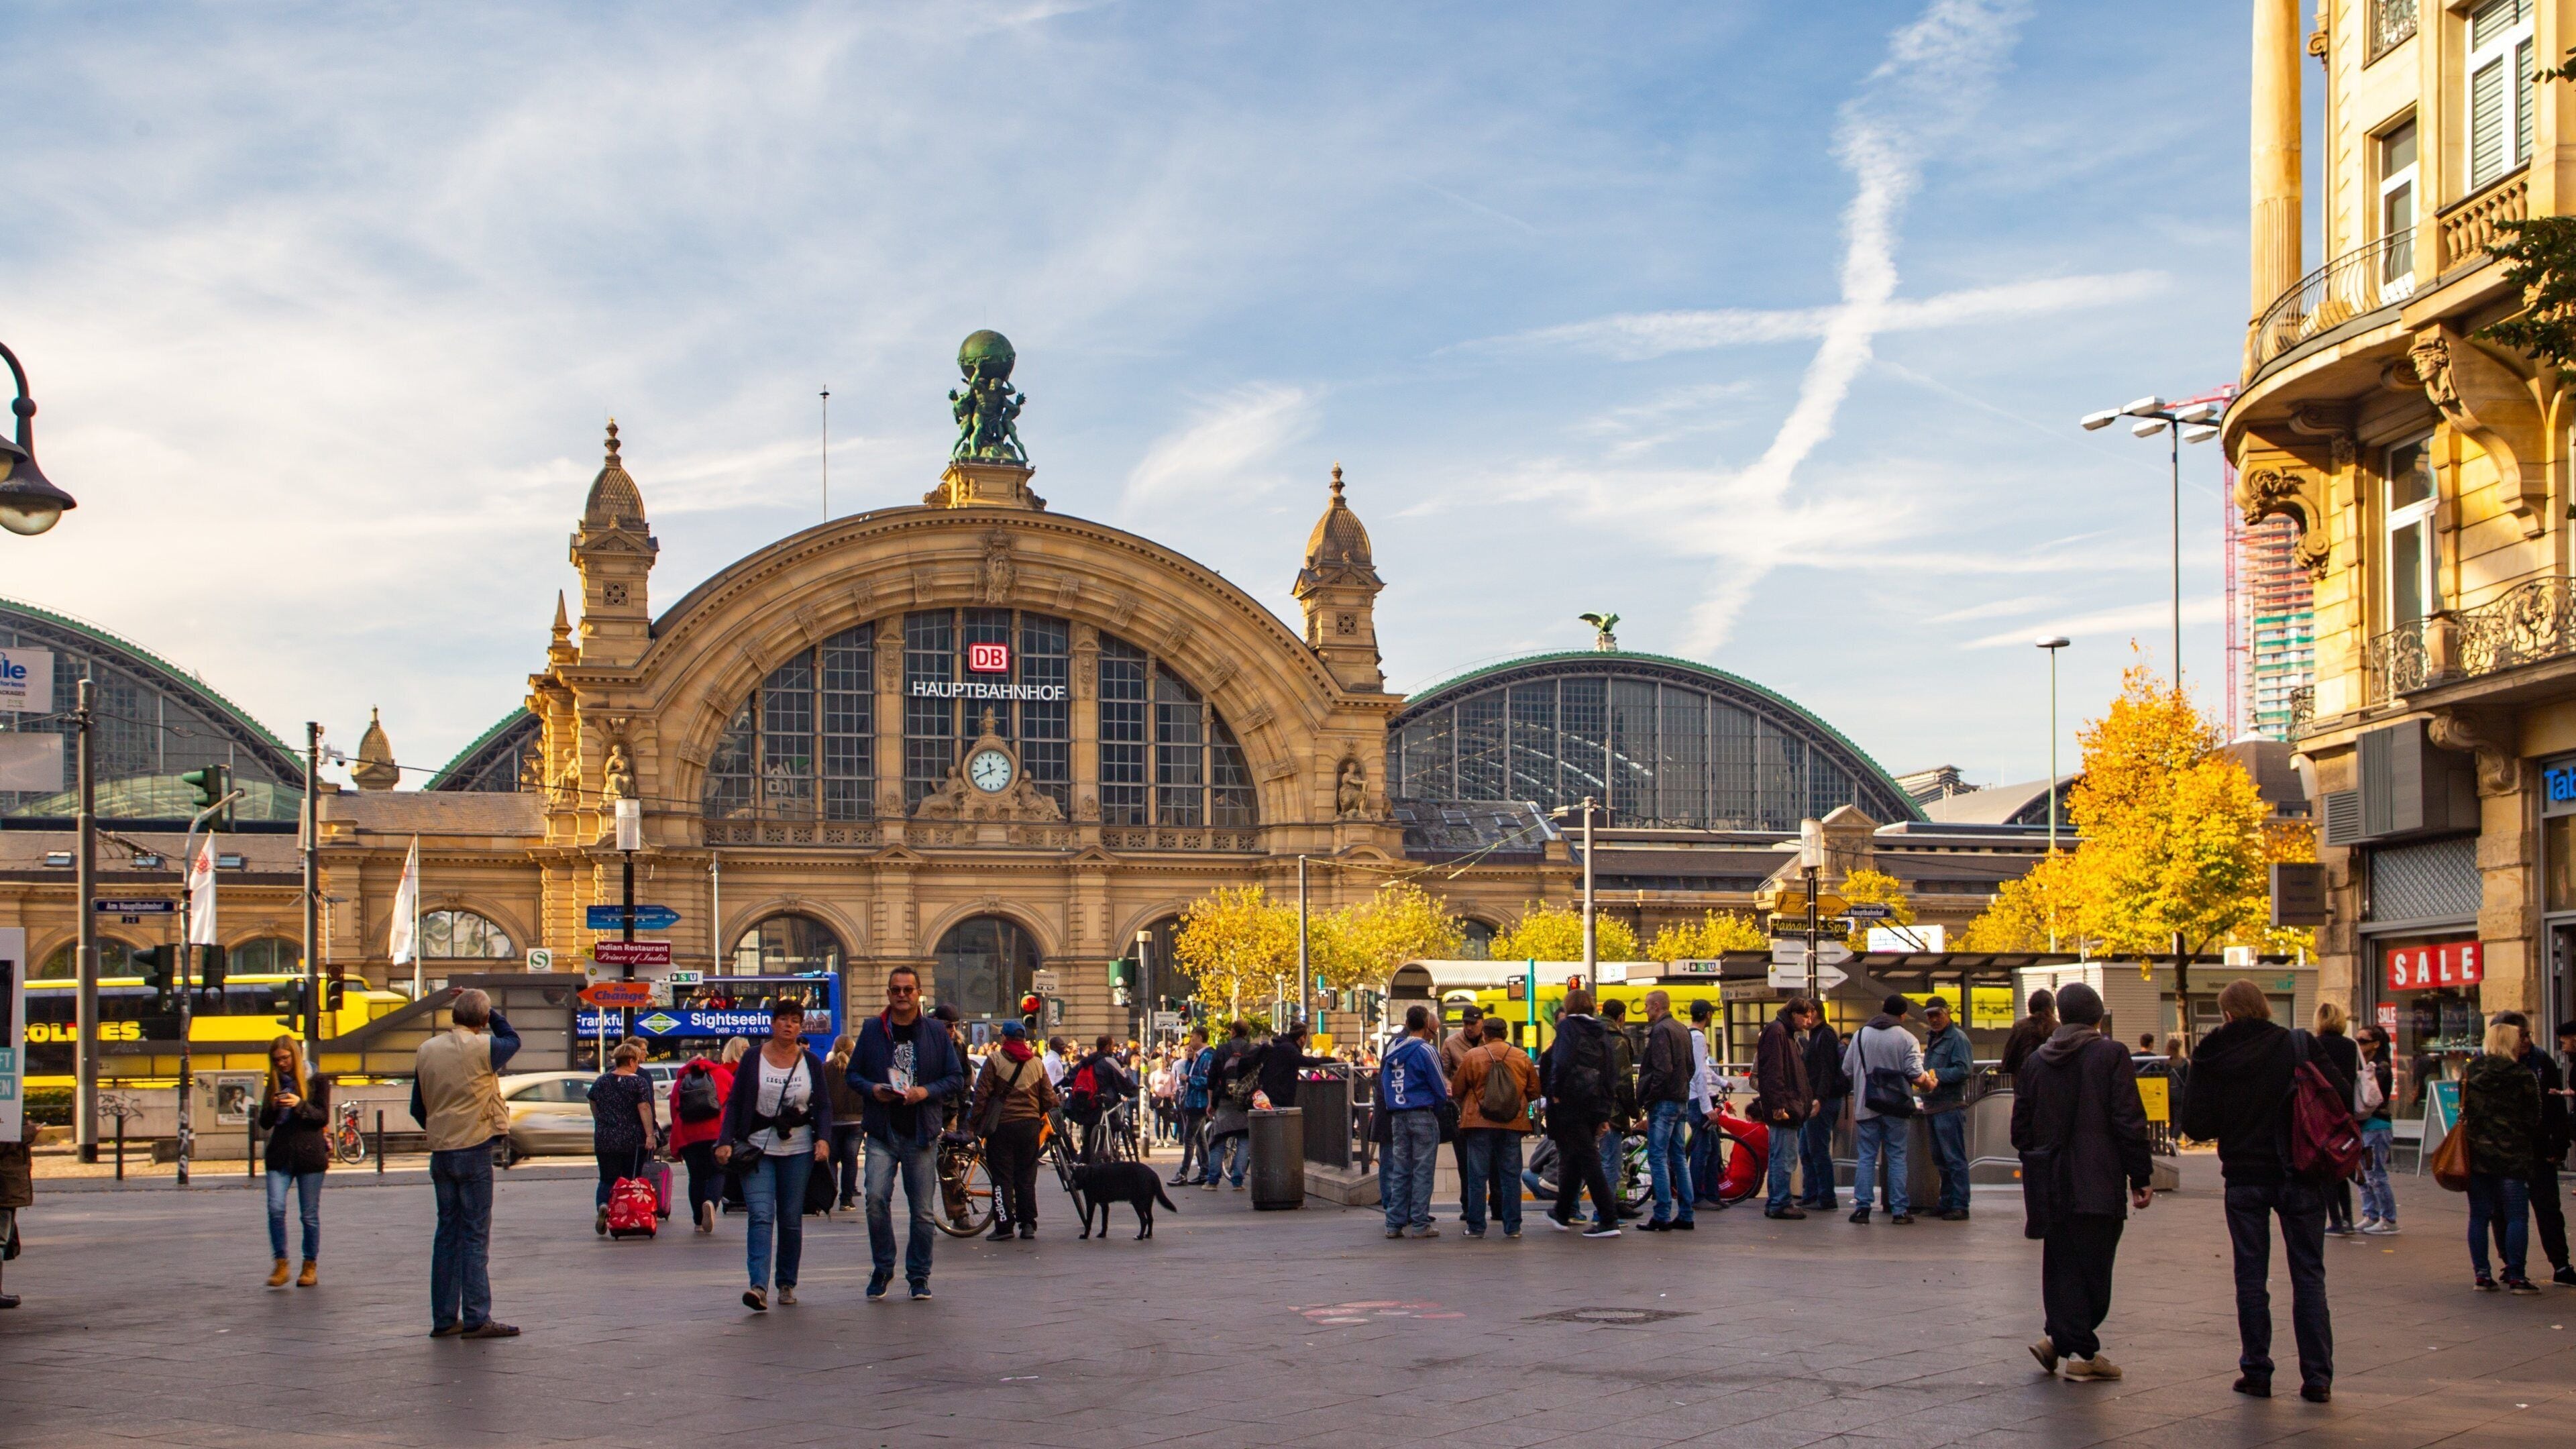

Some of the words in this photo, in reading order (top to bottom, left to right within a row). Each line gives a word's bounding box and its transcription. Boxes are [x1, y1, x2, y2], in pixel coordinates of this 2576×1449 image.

[976, 649, 1004, 666] DB
[0, 659, 27, 680] le
[913, 680, 1065, 701] HAUPTBAHNHOF
[1851, 908, 1884, 917] Hauptbahnhof
[1816, 921, 1825, 931] &
[1827, 922, 1847, 932] Spa
[597, 943, 623, 951] Indian
[624, 944, 668, 952] Restaurant
[597, 952, 628, 961] Prince
[629, 953, 641, 964] of
[640, 953, 668, 962] India
[2394, 947, 2474, 985] SALE
[594, 991, 646, 1003] Change
[2377, 1007, 2396, 1024] SALE
[766, 1076, 802, 1084] EXCLUIVE
